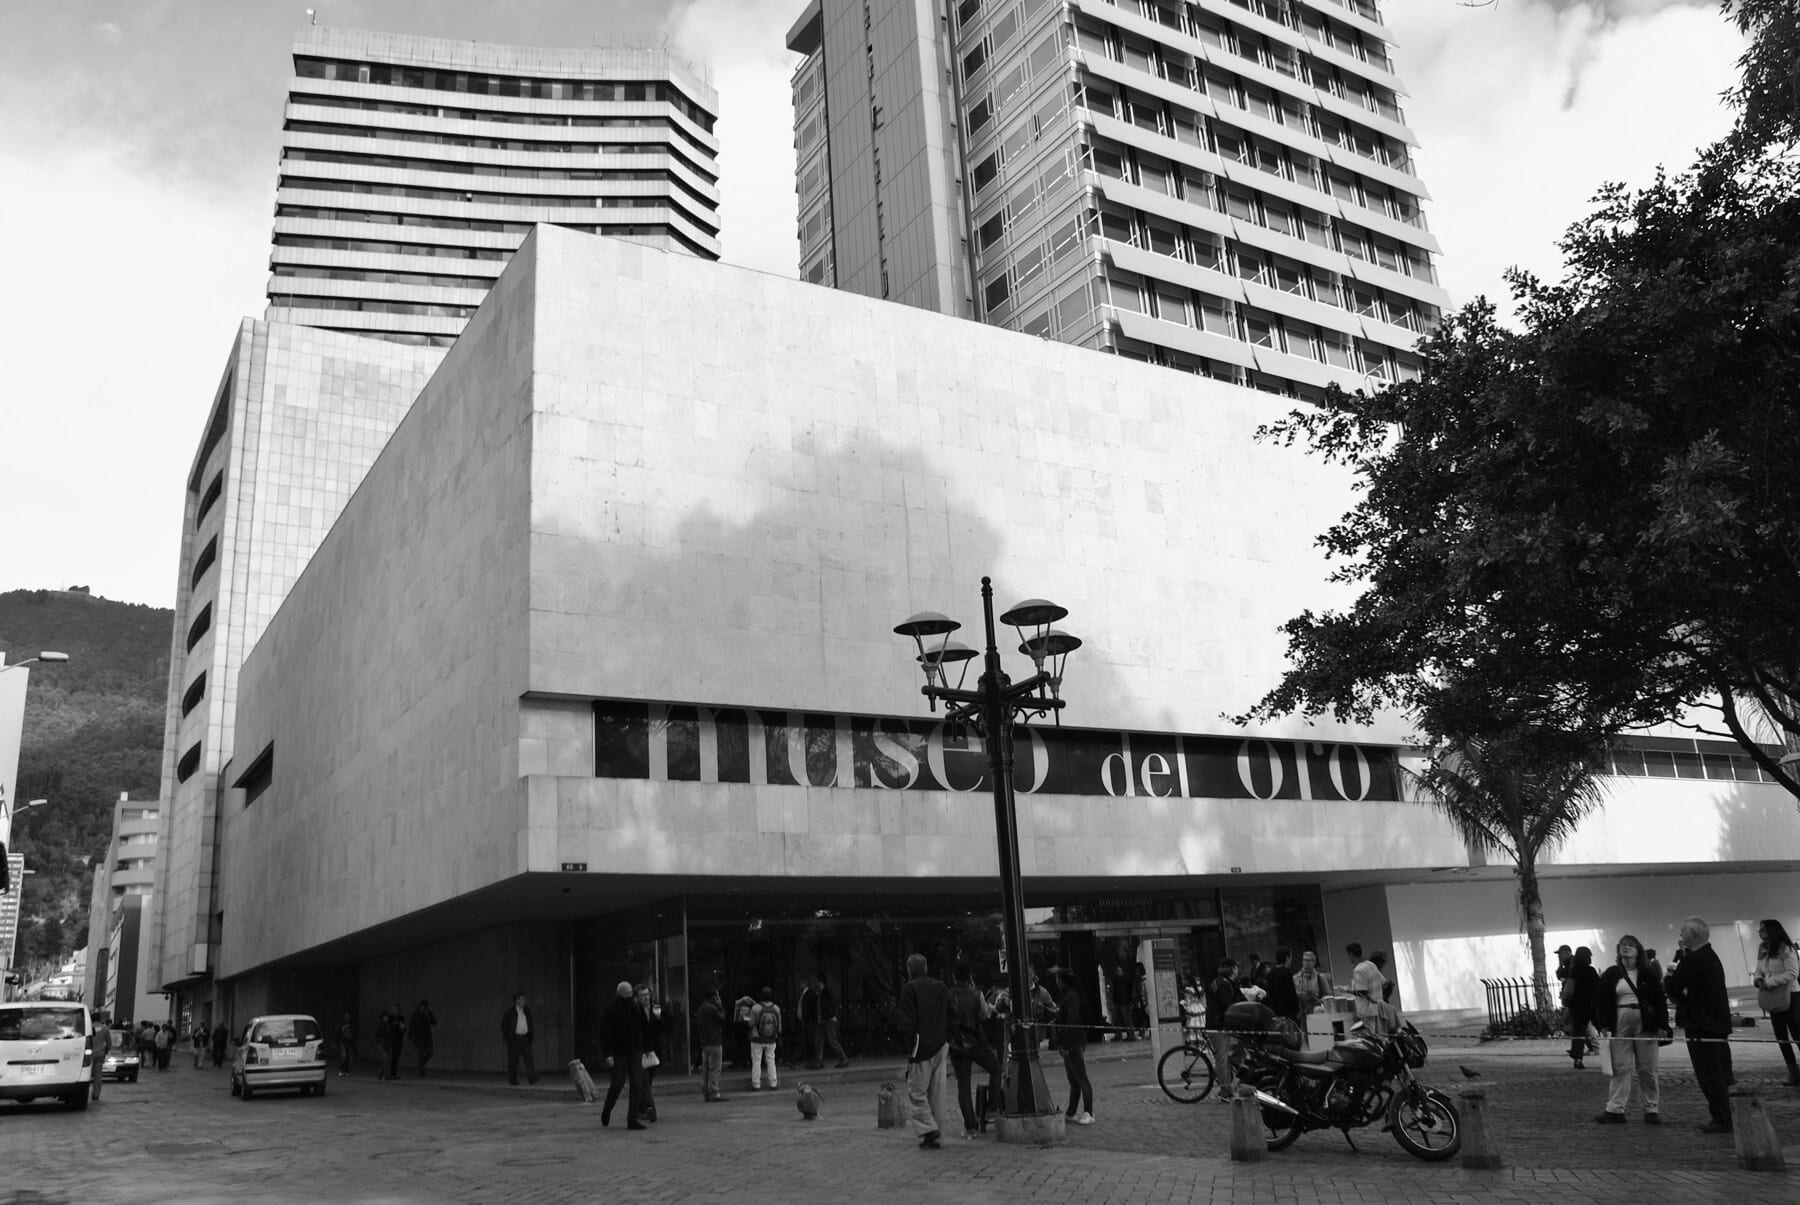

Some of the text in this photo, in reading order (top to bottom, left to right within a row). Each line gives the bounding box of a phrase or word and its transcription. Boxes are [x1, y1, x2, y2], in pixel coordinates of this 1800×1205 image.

[648, 702, 1371, 802] museo del oro
